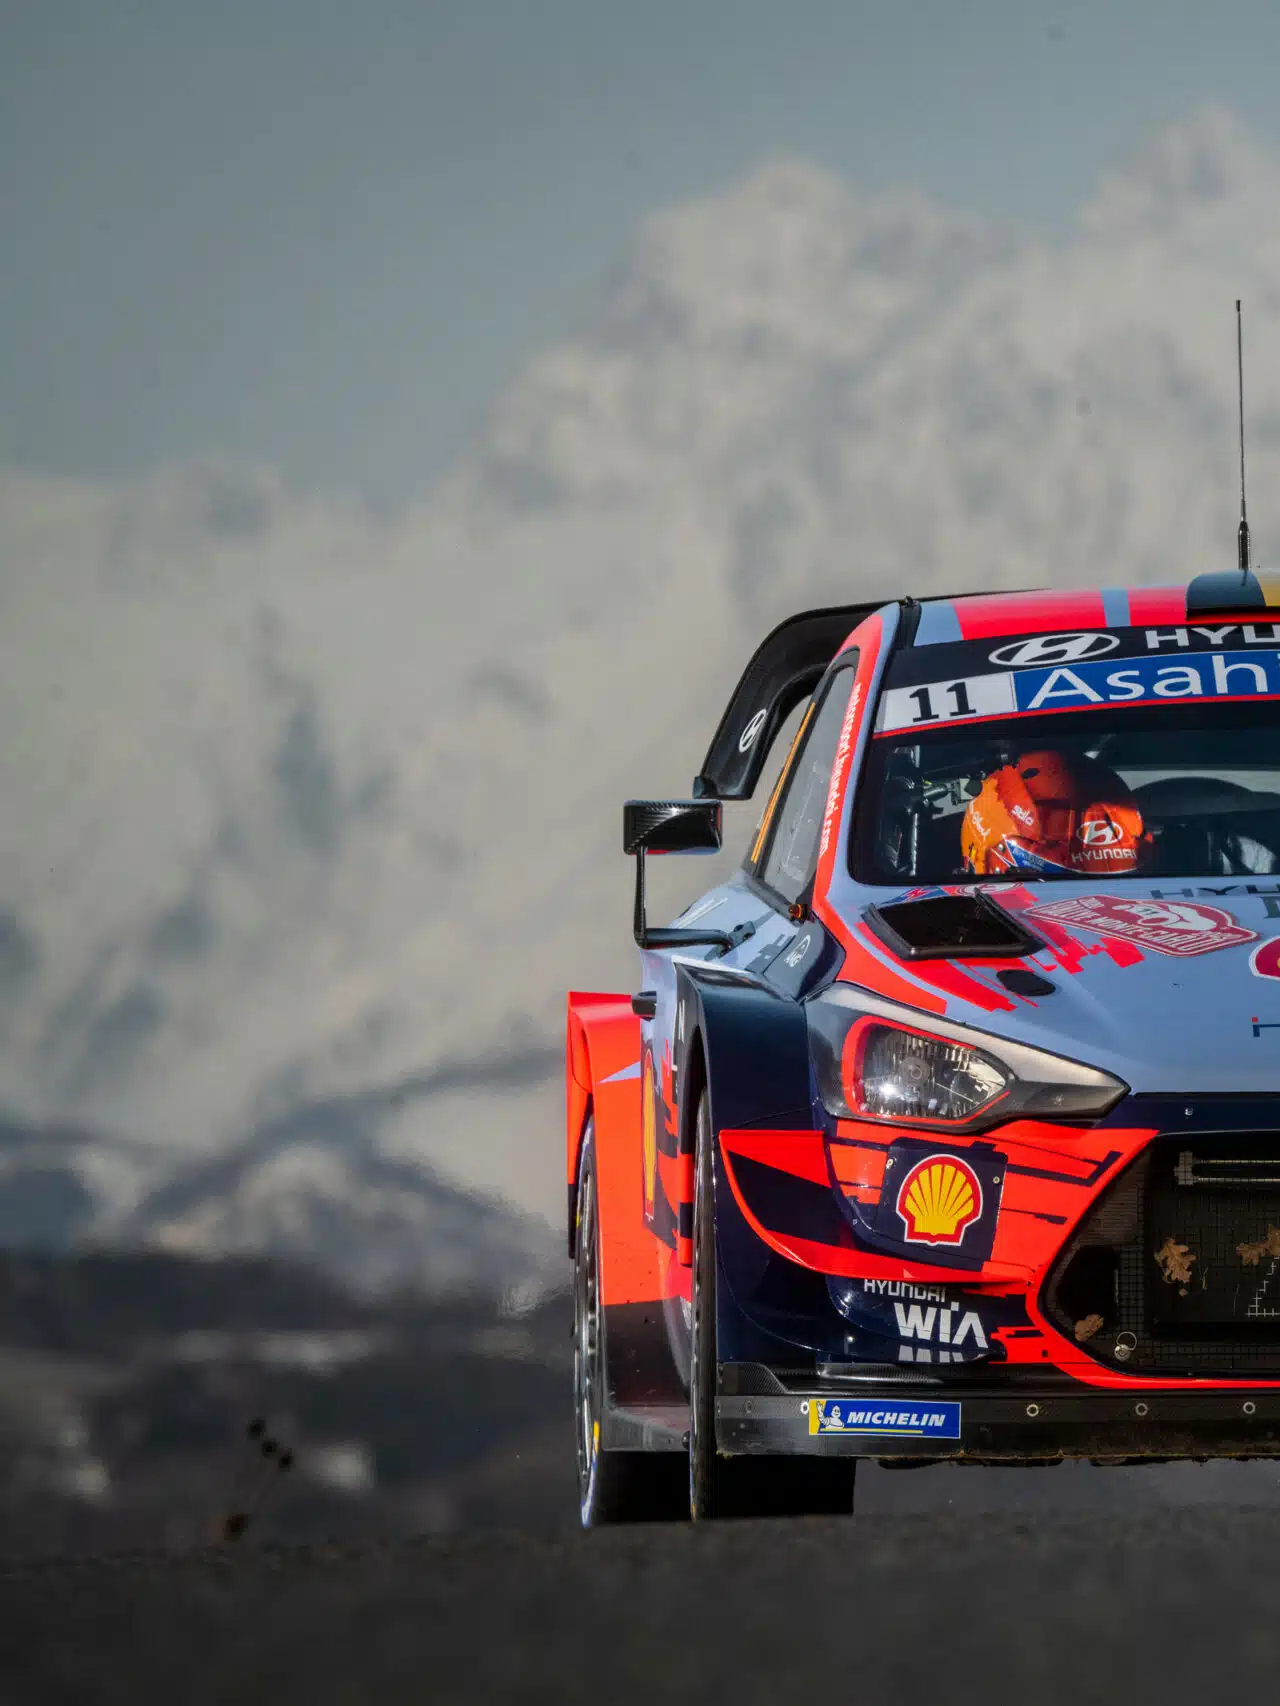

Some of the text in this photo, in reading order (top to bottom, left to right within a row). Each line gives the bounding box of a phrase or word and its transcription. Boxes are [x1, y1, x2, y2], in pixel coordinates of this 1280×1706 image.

[909, 681, 977, 723] 11
[1071, 848, 1137, 863] HYUNDAI
[863, 1278, 946, 1303] HYUNDAI
[847, 1410, 947, 1427] MICHELIN
